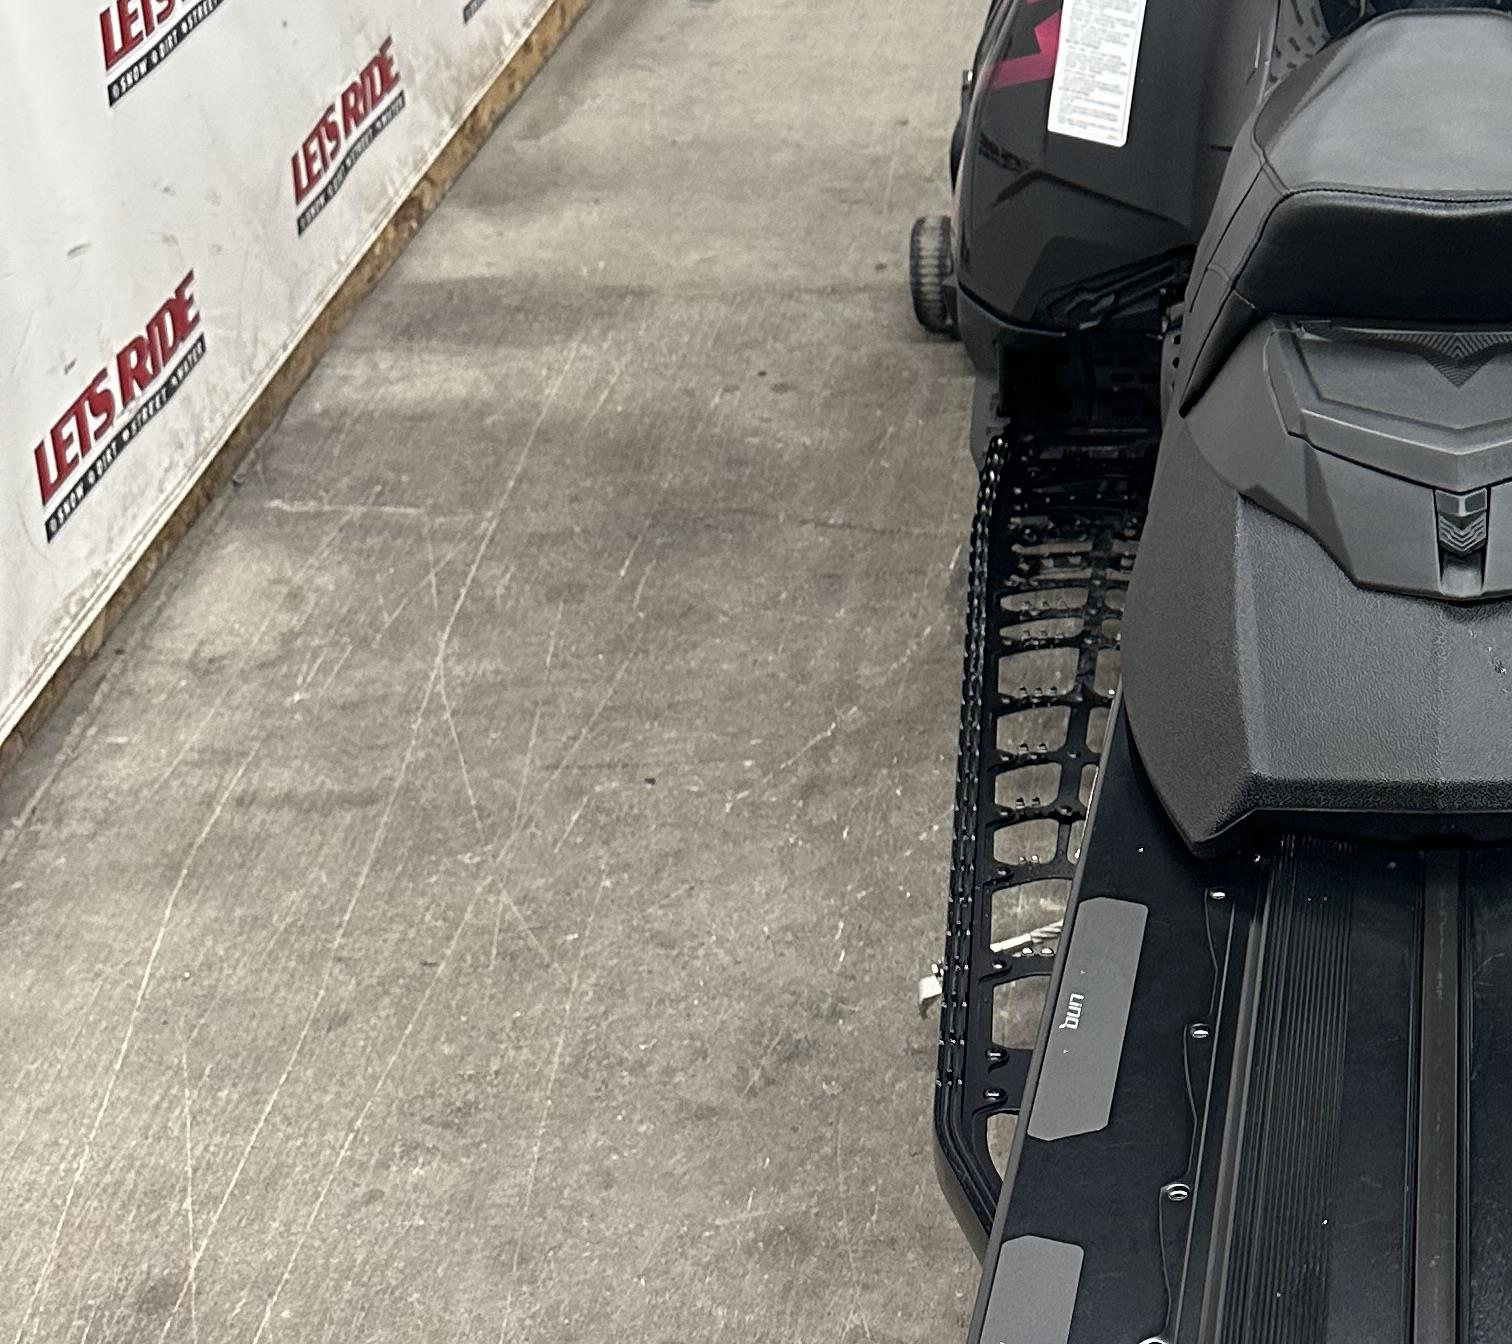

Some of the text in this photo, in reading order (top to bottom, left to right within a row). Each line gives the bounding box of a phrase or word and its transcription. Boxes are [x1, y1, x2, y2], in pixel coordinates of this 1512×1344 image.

[159, 28, 178, 57] DIRT
[291, 103, 341, 206] LETS
[341, 35, 401, 141] RIDE
[34, 268, 202, 506] LETS RIDE
[95, 445, 118, 480] DIRT
[130, 388, 169, 434] STREET
